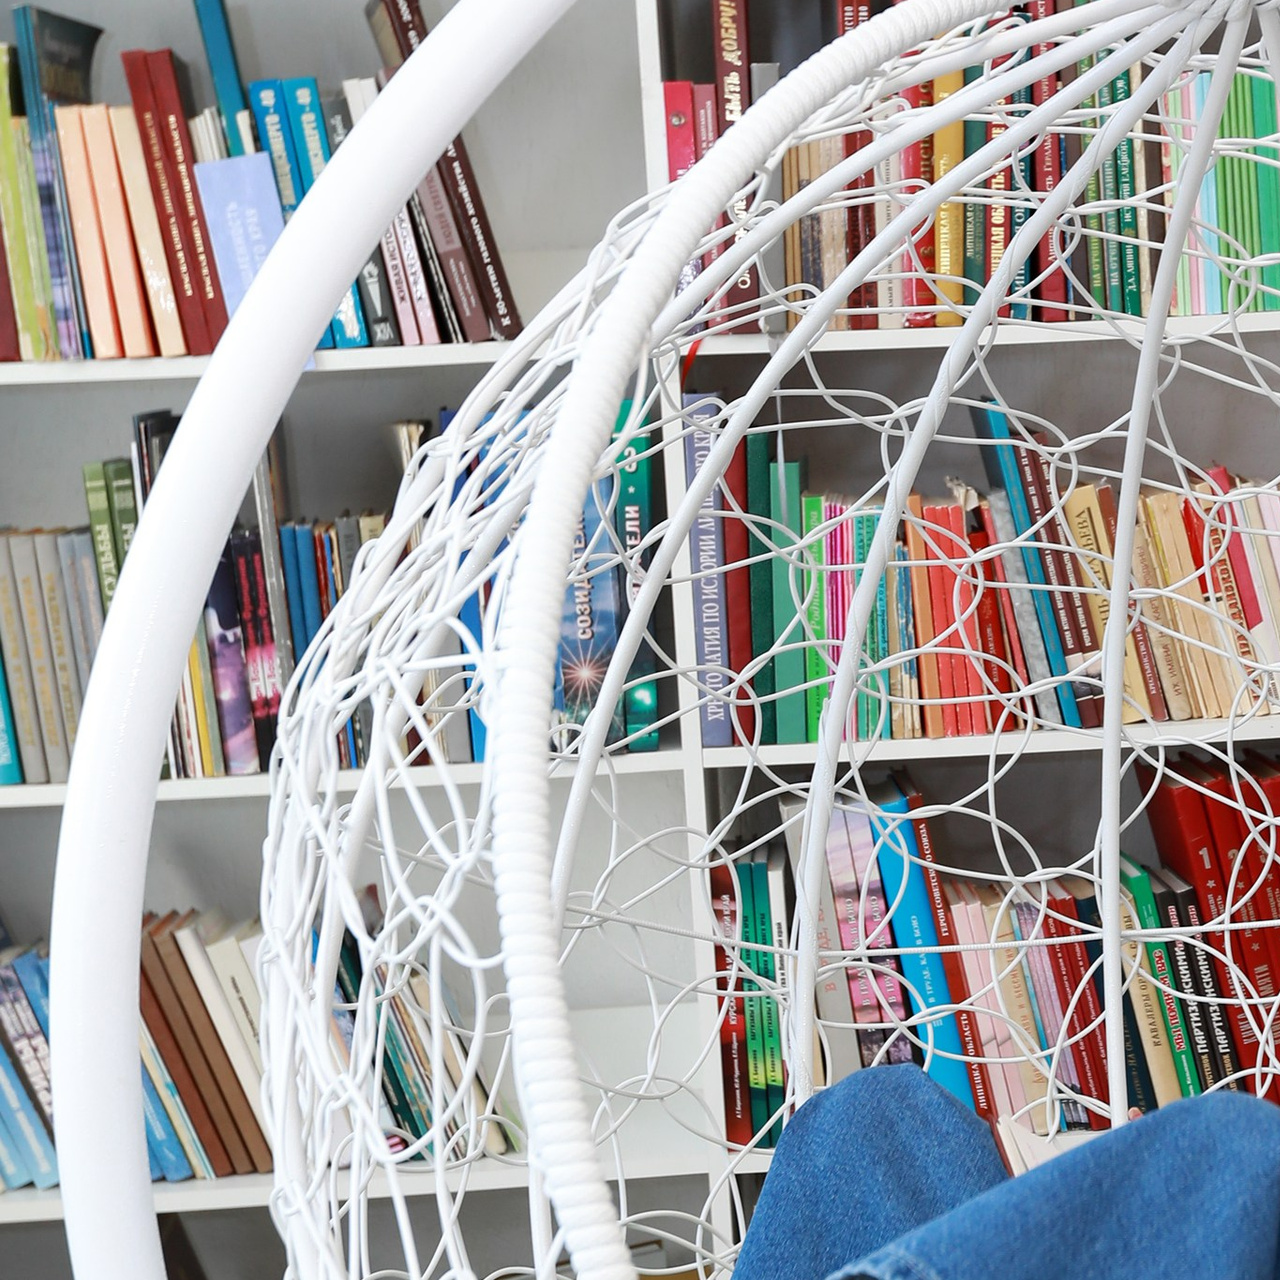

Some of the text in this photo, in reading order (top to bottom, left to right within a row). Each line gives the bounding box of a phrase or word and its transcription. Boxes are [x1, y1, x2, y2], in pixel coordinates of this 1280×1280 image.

[721, 71, 742, 121] БЫТЬ
[451, 160, 475, 216] хозяйства
[470, 216, 493, 263] газового
[388, 262, 407, 304] ЖИВАЯ
[95, 523, 117, 597] СУДЬБЫ
[703, 603, 719, 623] ПО
[1162, 643, 1177, 679] ИМЕНА
[1171, 681, 1183, 697] ИХ
[918, 823, 950, 937] ГЕРОИ СОЮЗА
[721, 894, 732, 916] КРАЙ
[843, 898, 856, 925] БОЮ
[868, 895, 881, 922] БОЮ
[909, 915, 921, 938] БОЮ
[1142, 993, 1162, 1048] КАВАЛЕРЫ
[1152, 949, 1187, 1052] МЫ ВАС
[959, 1013, 975, 1056] ОБЛАСТЬ
